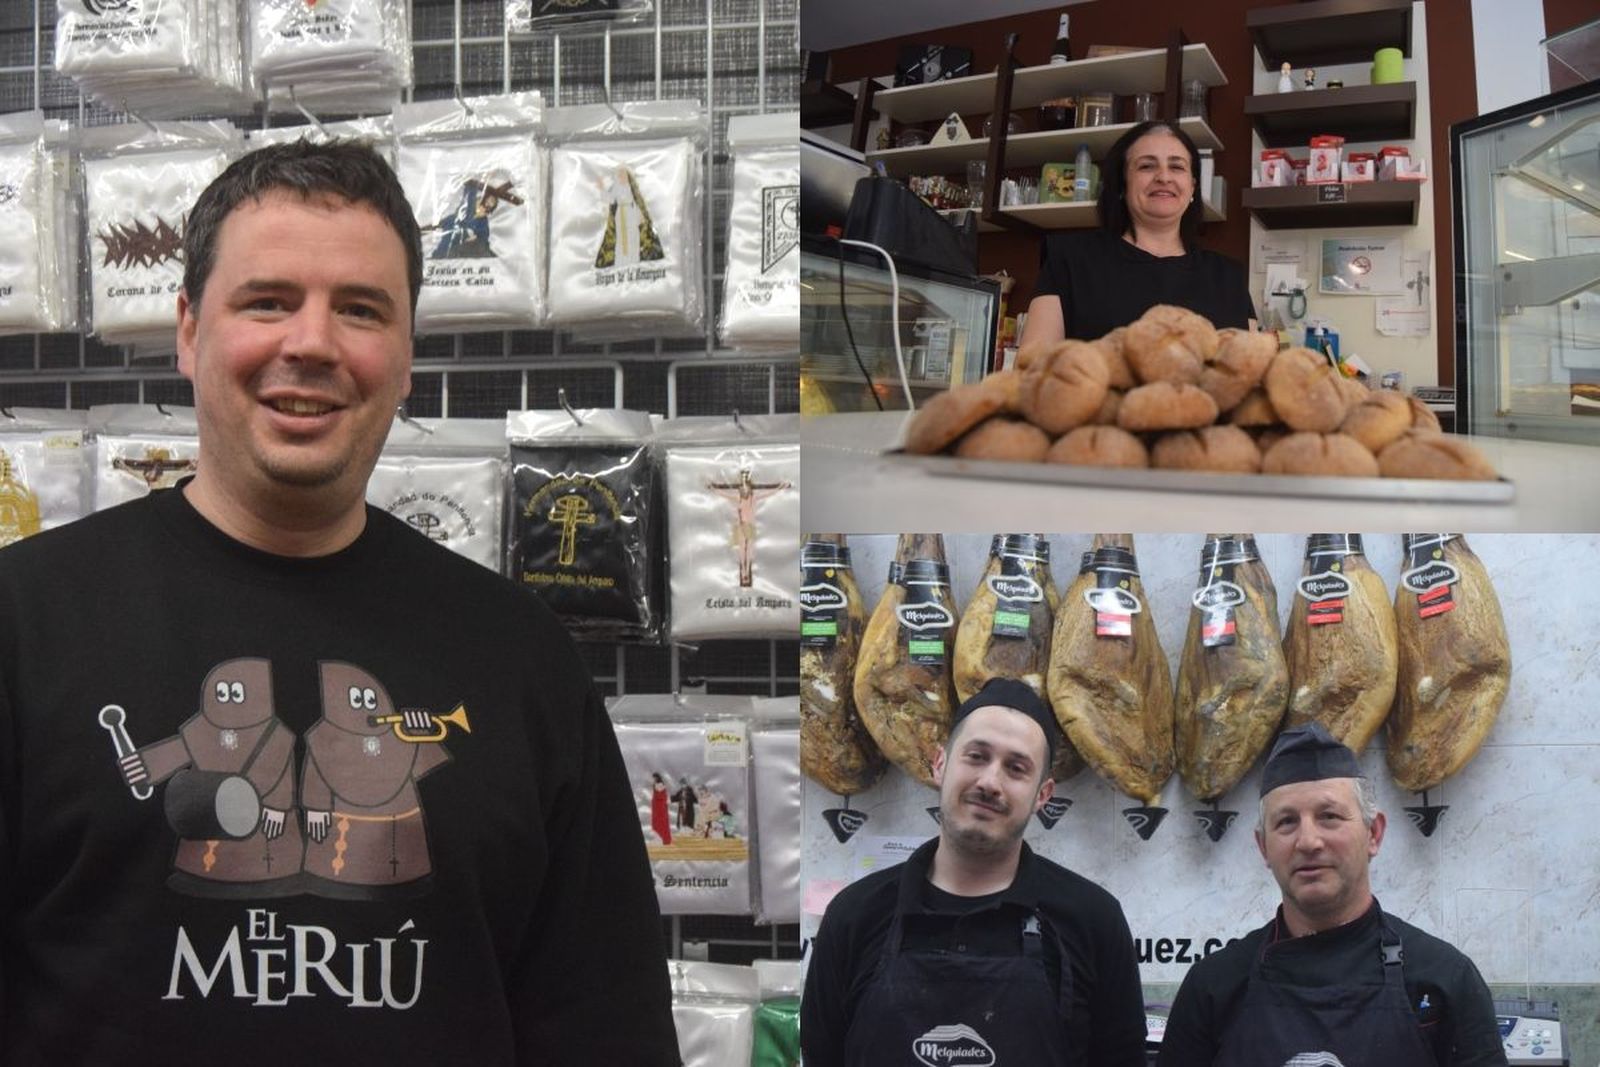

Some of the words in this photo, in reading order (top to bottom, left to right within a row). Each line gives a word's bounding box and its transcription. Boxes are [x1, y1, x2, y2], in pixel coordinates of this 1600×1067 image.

[663, 874, 728, 888] Sentencia
[246, 908, 286, 941] EL
[920, 1042, 987, 1063] Melquiades
